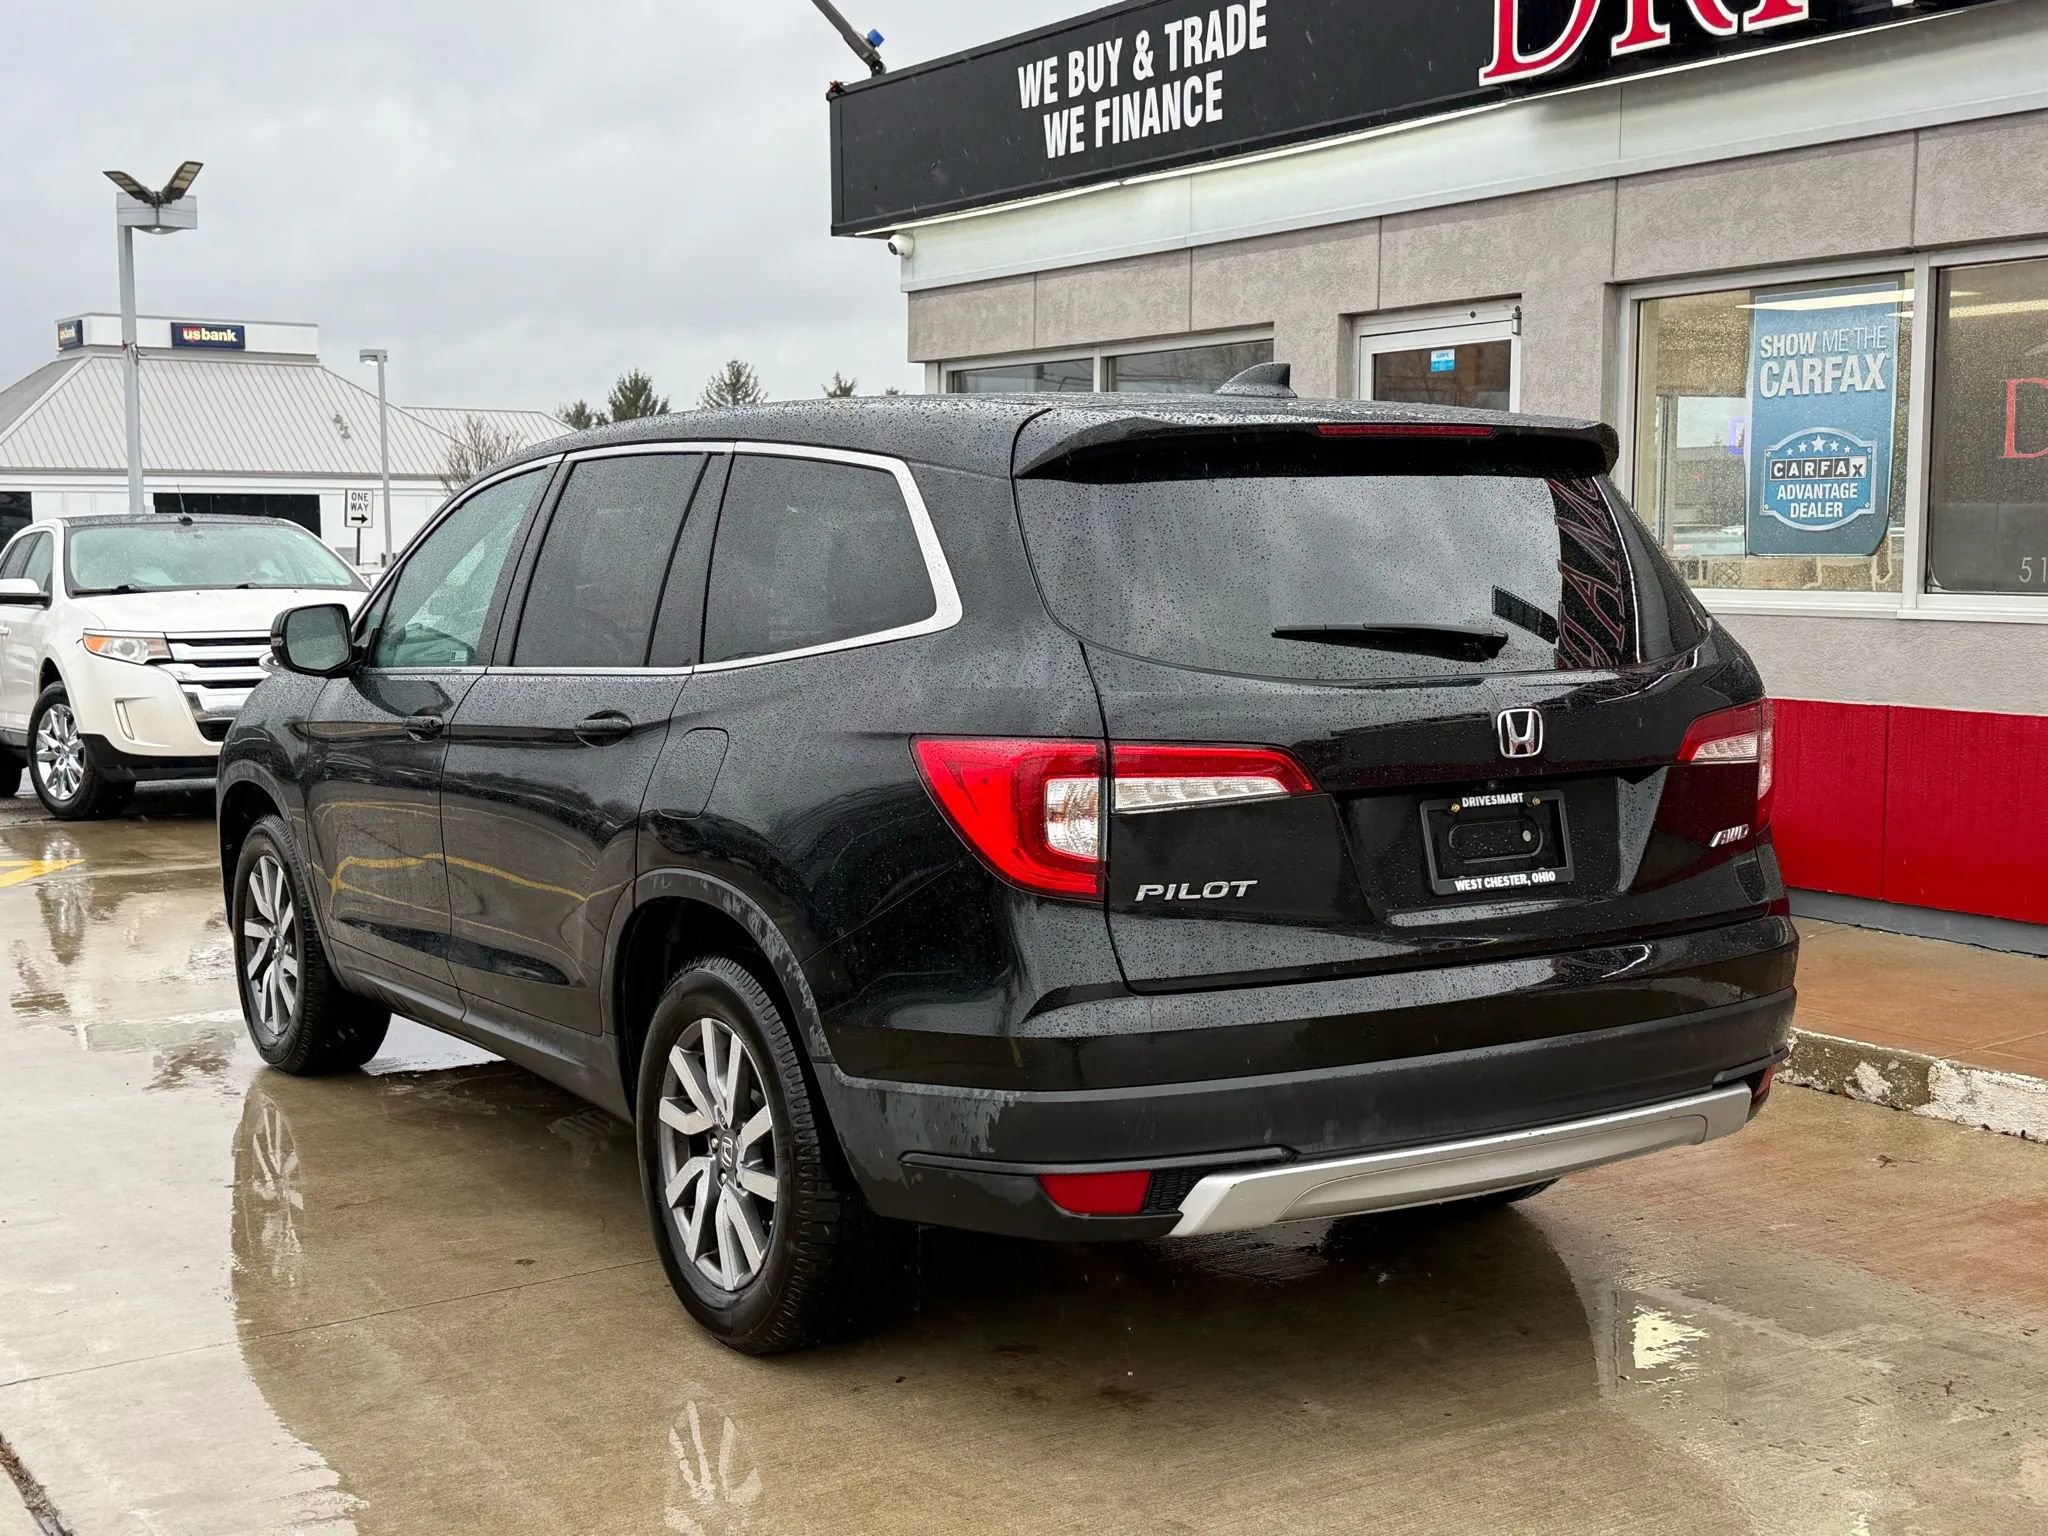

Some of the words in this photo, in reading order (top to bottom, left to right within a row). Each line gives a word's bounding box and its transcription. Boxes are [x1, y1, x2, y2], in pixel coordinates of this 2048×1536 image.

[1018, 56, 1058, 109] WE
[1068, 37, 1123, 98] BUY
[1132, 29, 1155, 81] &
[1164, 0, 1268, 72] TRADE
[1043, 105, 1085, 159] WE
[1095, 69, 1223, 148] FINANCE
[183, 327, 238, 342] usbank
[1760, 331, 1818, 359] SHOW
[1822, 329, 1849, 353] ME
[1854, 325, 1888, 350] THE
[1760, 352, 1887, 398] CARFAX
[1772, 459, 1865, 478] CARFAX
[351, 492, 369, 502] ONE
[1776, 483, 1859, 500] ADVANTAGE
[350, 502, 369, 512] WAY
[1790, 502, 1843, 518] DEALER
[1462, 792, 1524, 808] DRIVESMART
[1134, 880, 1259, 902] PILOT
[1454, 878, 1483, 892] WEST
[1484, 873, 1531, 887] CHESTER,
[1531, 871, 1556, 883] OHIO
